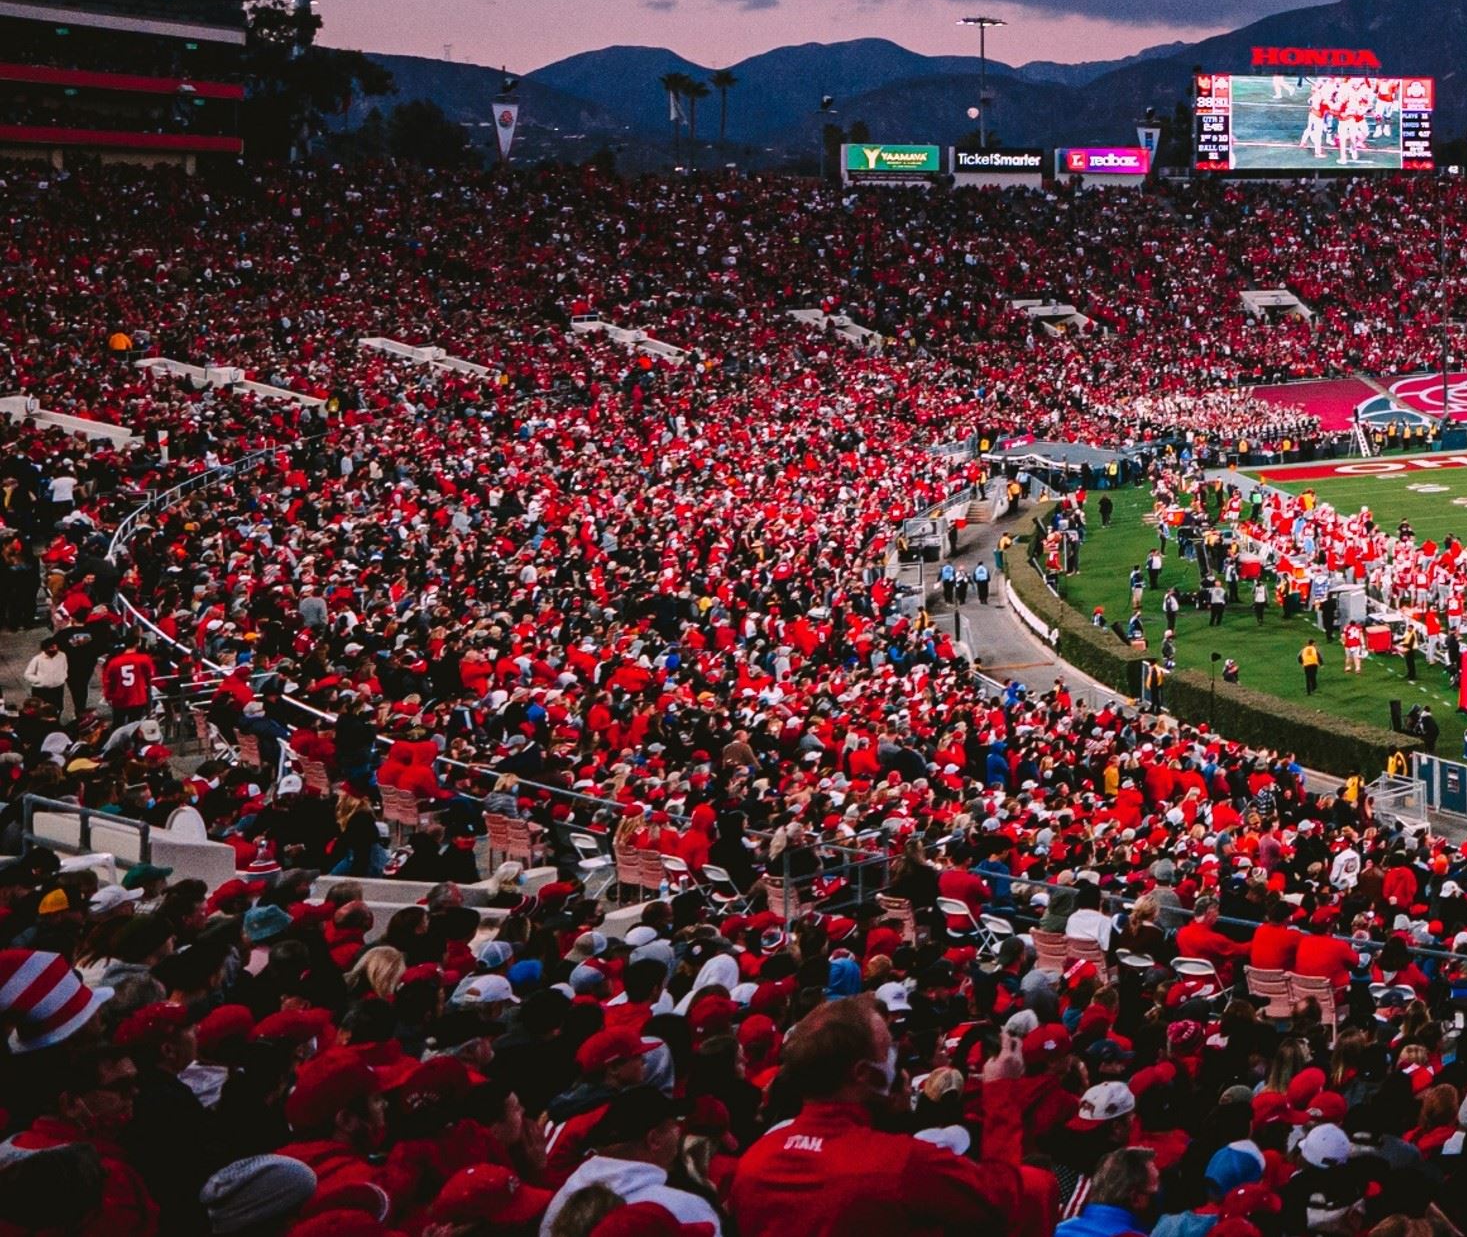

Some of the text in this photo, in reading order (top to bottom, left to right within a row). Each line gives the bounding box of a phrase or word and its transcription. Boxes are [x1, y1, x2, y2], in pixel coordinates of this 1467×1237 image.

[1250, 46, 1381, 68] HONDA
[958, 153, 1041, 167] TicketSmarter
[121, 665, 135, 687] 5
[784, 1134, 823, 1152] UTAH
